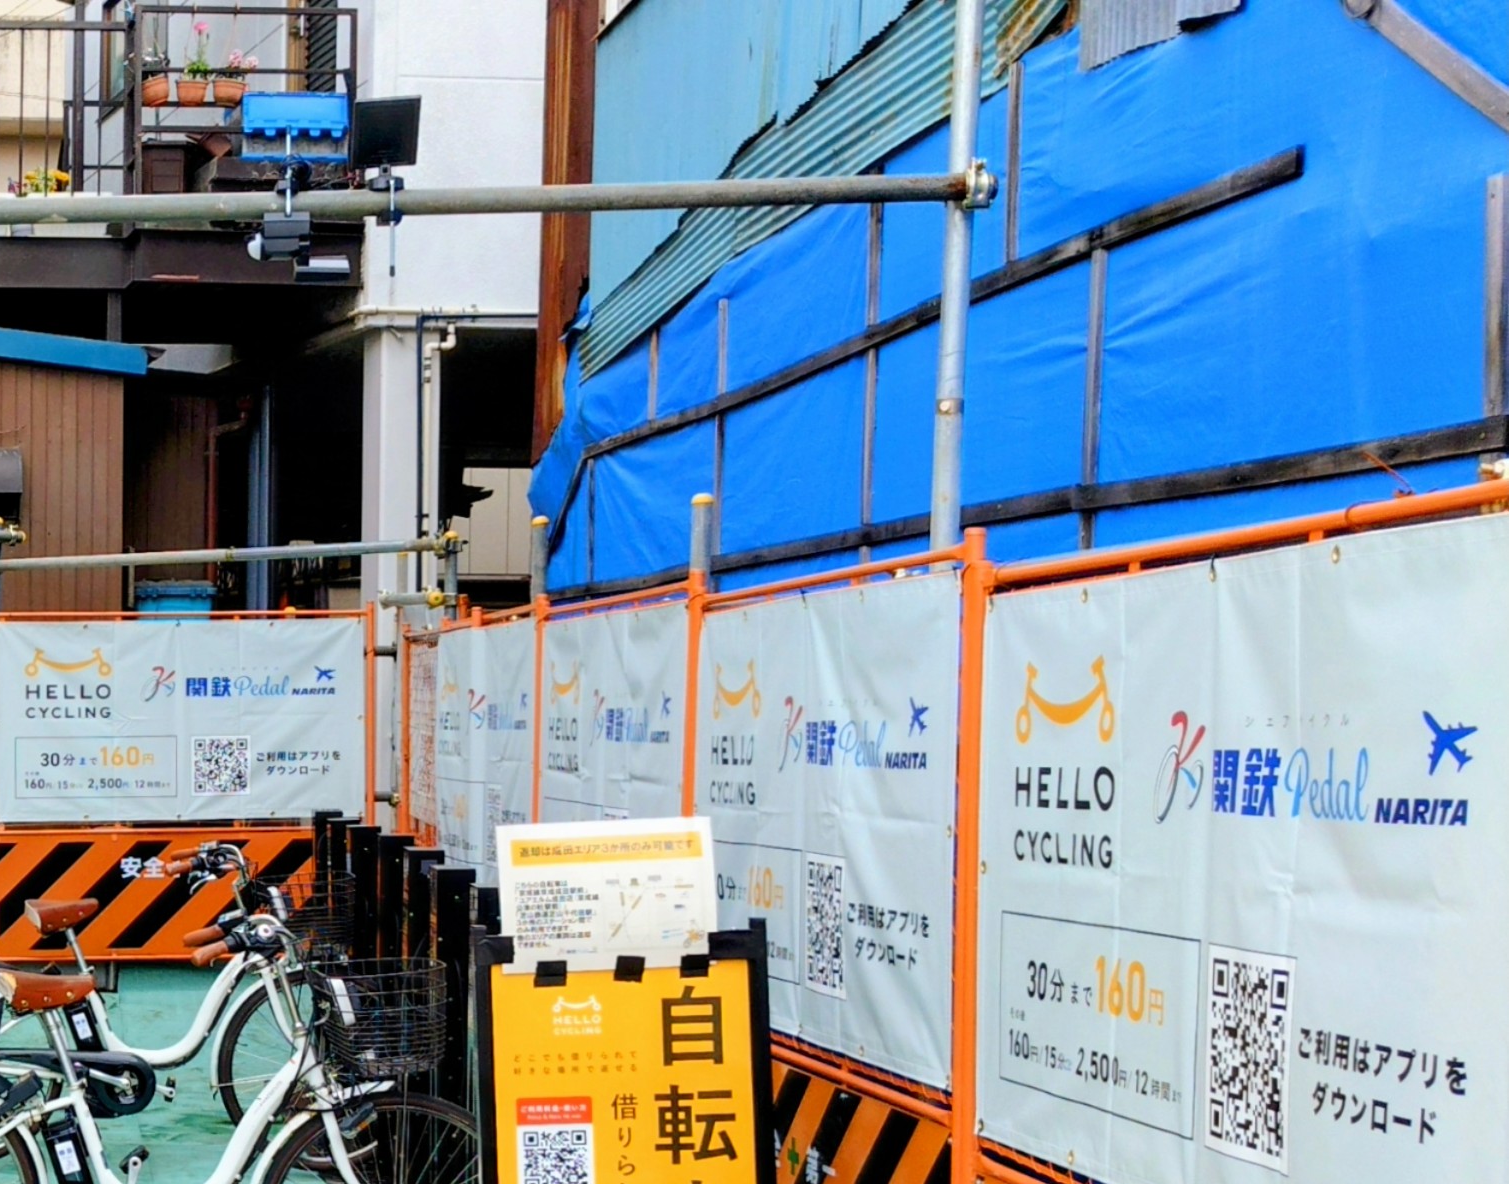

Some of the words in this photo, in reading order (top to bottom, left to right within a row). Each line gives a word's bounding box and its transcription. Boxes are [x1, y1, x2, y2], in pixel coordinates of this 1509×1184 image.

[25, 684, 111, 700] HELLO
[291, 687, 336, 695] NARITA
[25, 706, 112, 719] CYCLING
[256, 750, 341, 762] ご利用はアプリを
[710, 733, 754, 766] HELLO
[885, 752, 927, 770] NARITA
[265, 764, 331, 775] ダウンロード
[709, 780, 756, 806] CYCLING
[1015, 765, 1115, 812] HELLO
[1374, 798, 1469, 826] NARITA
[1014, 829, 1114, 869] CYCLING
[120, 857, 167, 879] 安全
[846, 901, 930, 939] ご利用はアプリを
[854, 935, 918, 969] ダウンロード
[553, 1014, 602, 1025] HELLO
[1297, 1026, 1468, 1098] ご利用はアプリを
[1312, 1081, 1438, 1146] ダウンロード
